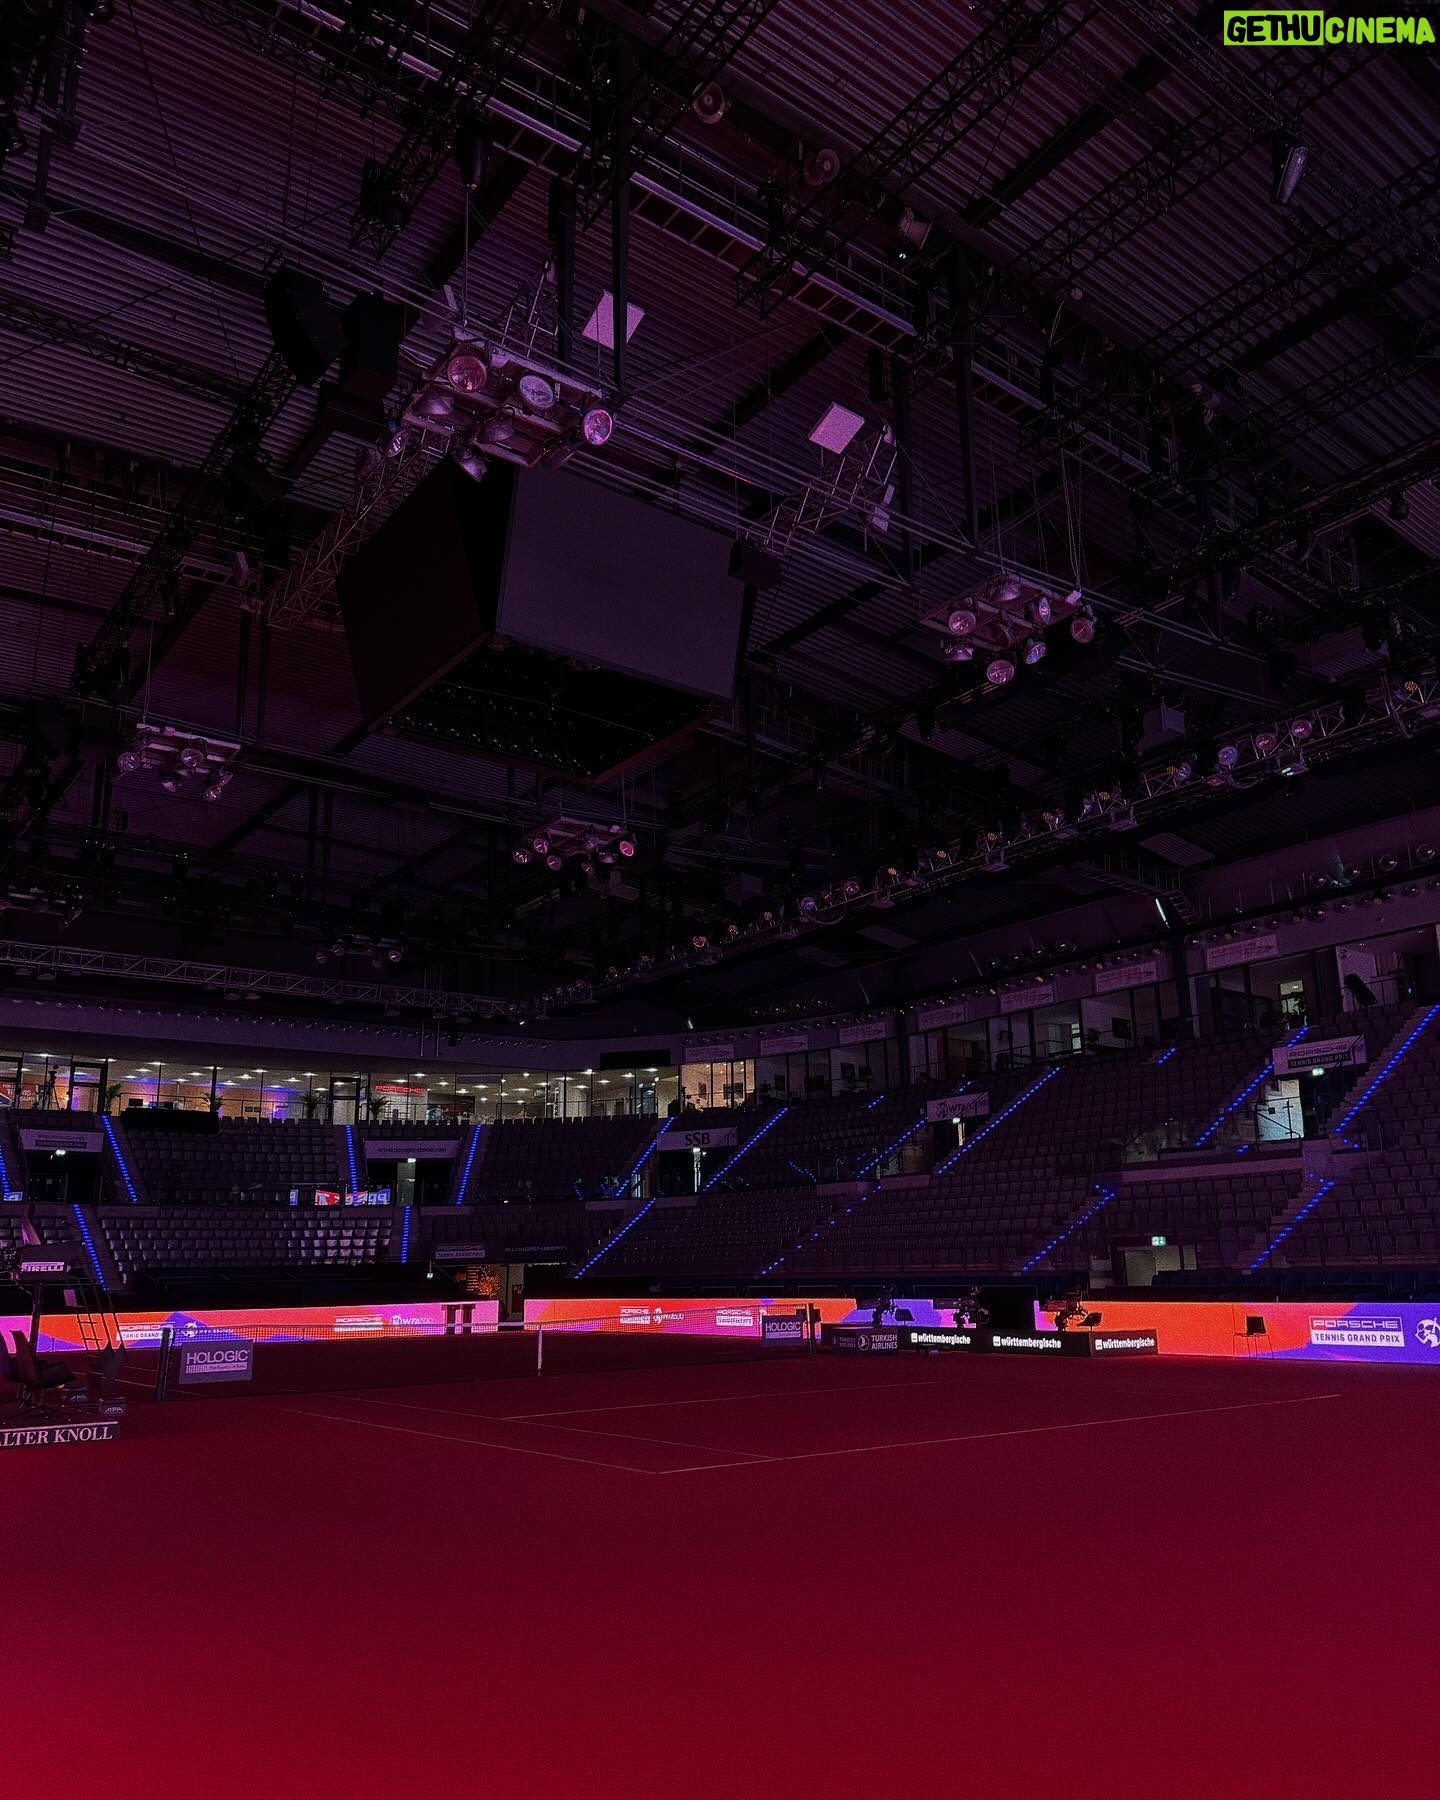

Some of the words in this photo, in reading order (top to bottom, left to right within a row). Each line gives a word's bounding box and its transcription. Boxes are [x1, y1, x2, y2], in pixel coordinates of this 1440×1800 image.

[685, 1132, 711, 1146] SSB
[765, 1322, 801, 1332] HOLOGIC
[1313, 1319, 1399, 1329] PORSCHE
[871, 1334, 897, 1342] TURKISH
[1001, 1336, 1062, 1350] württembergische
[1103, 1337, 1155, 1349] württembergische
[1315, 1333, 1345, 1342] TENNIS
[1347, 1334, 1377, 1343] GRAND
[1379, 1335, 1400, 1343] PRIX
[871, 1341, 898, 1350] AIRLINES
[186, 1350, 248, 1365] HOLOGIC
[54, 1426, 113, 1443] KNOLL
